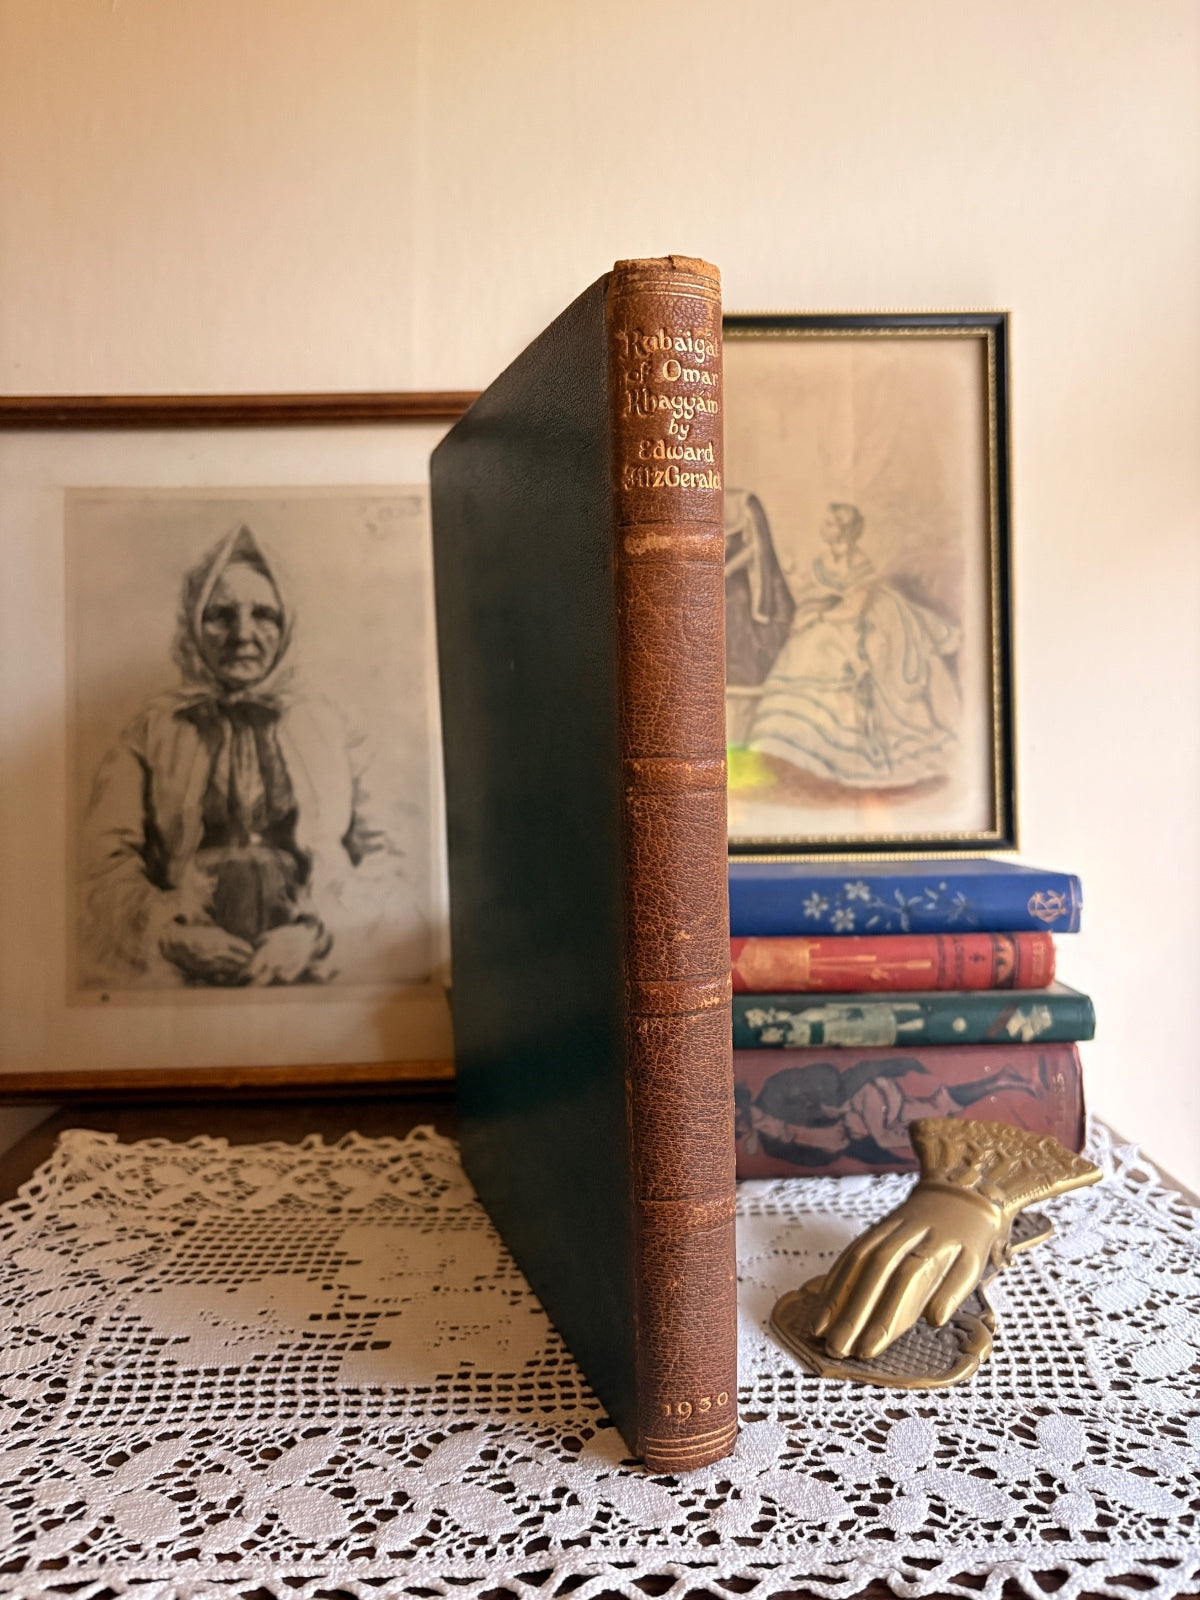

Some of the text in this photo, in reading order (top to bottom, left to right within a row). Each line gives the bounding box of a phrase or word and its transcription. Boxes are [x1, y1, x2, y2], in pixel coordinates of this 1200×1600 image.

[624, 359, 719, 386] of Omar
[669, 418, 690, 440] by
[639, 439, 715, 463] Edward
